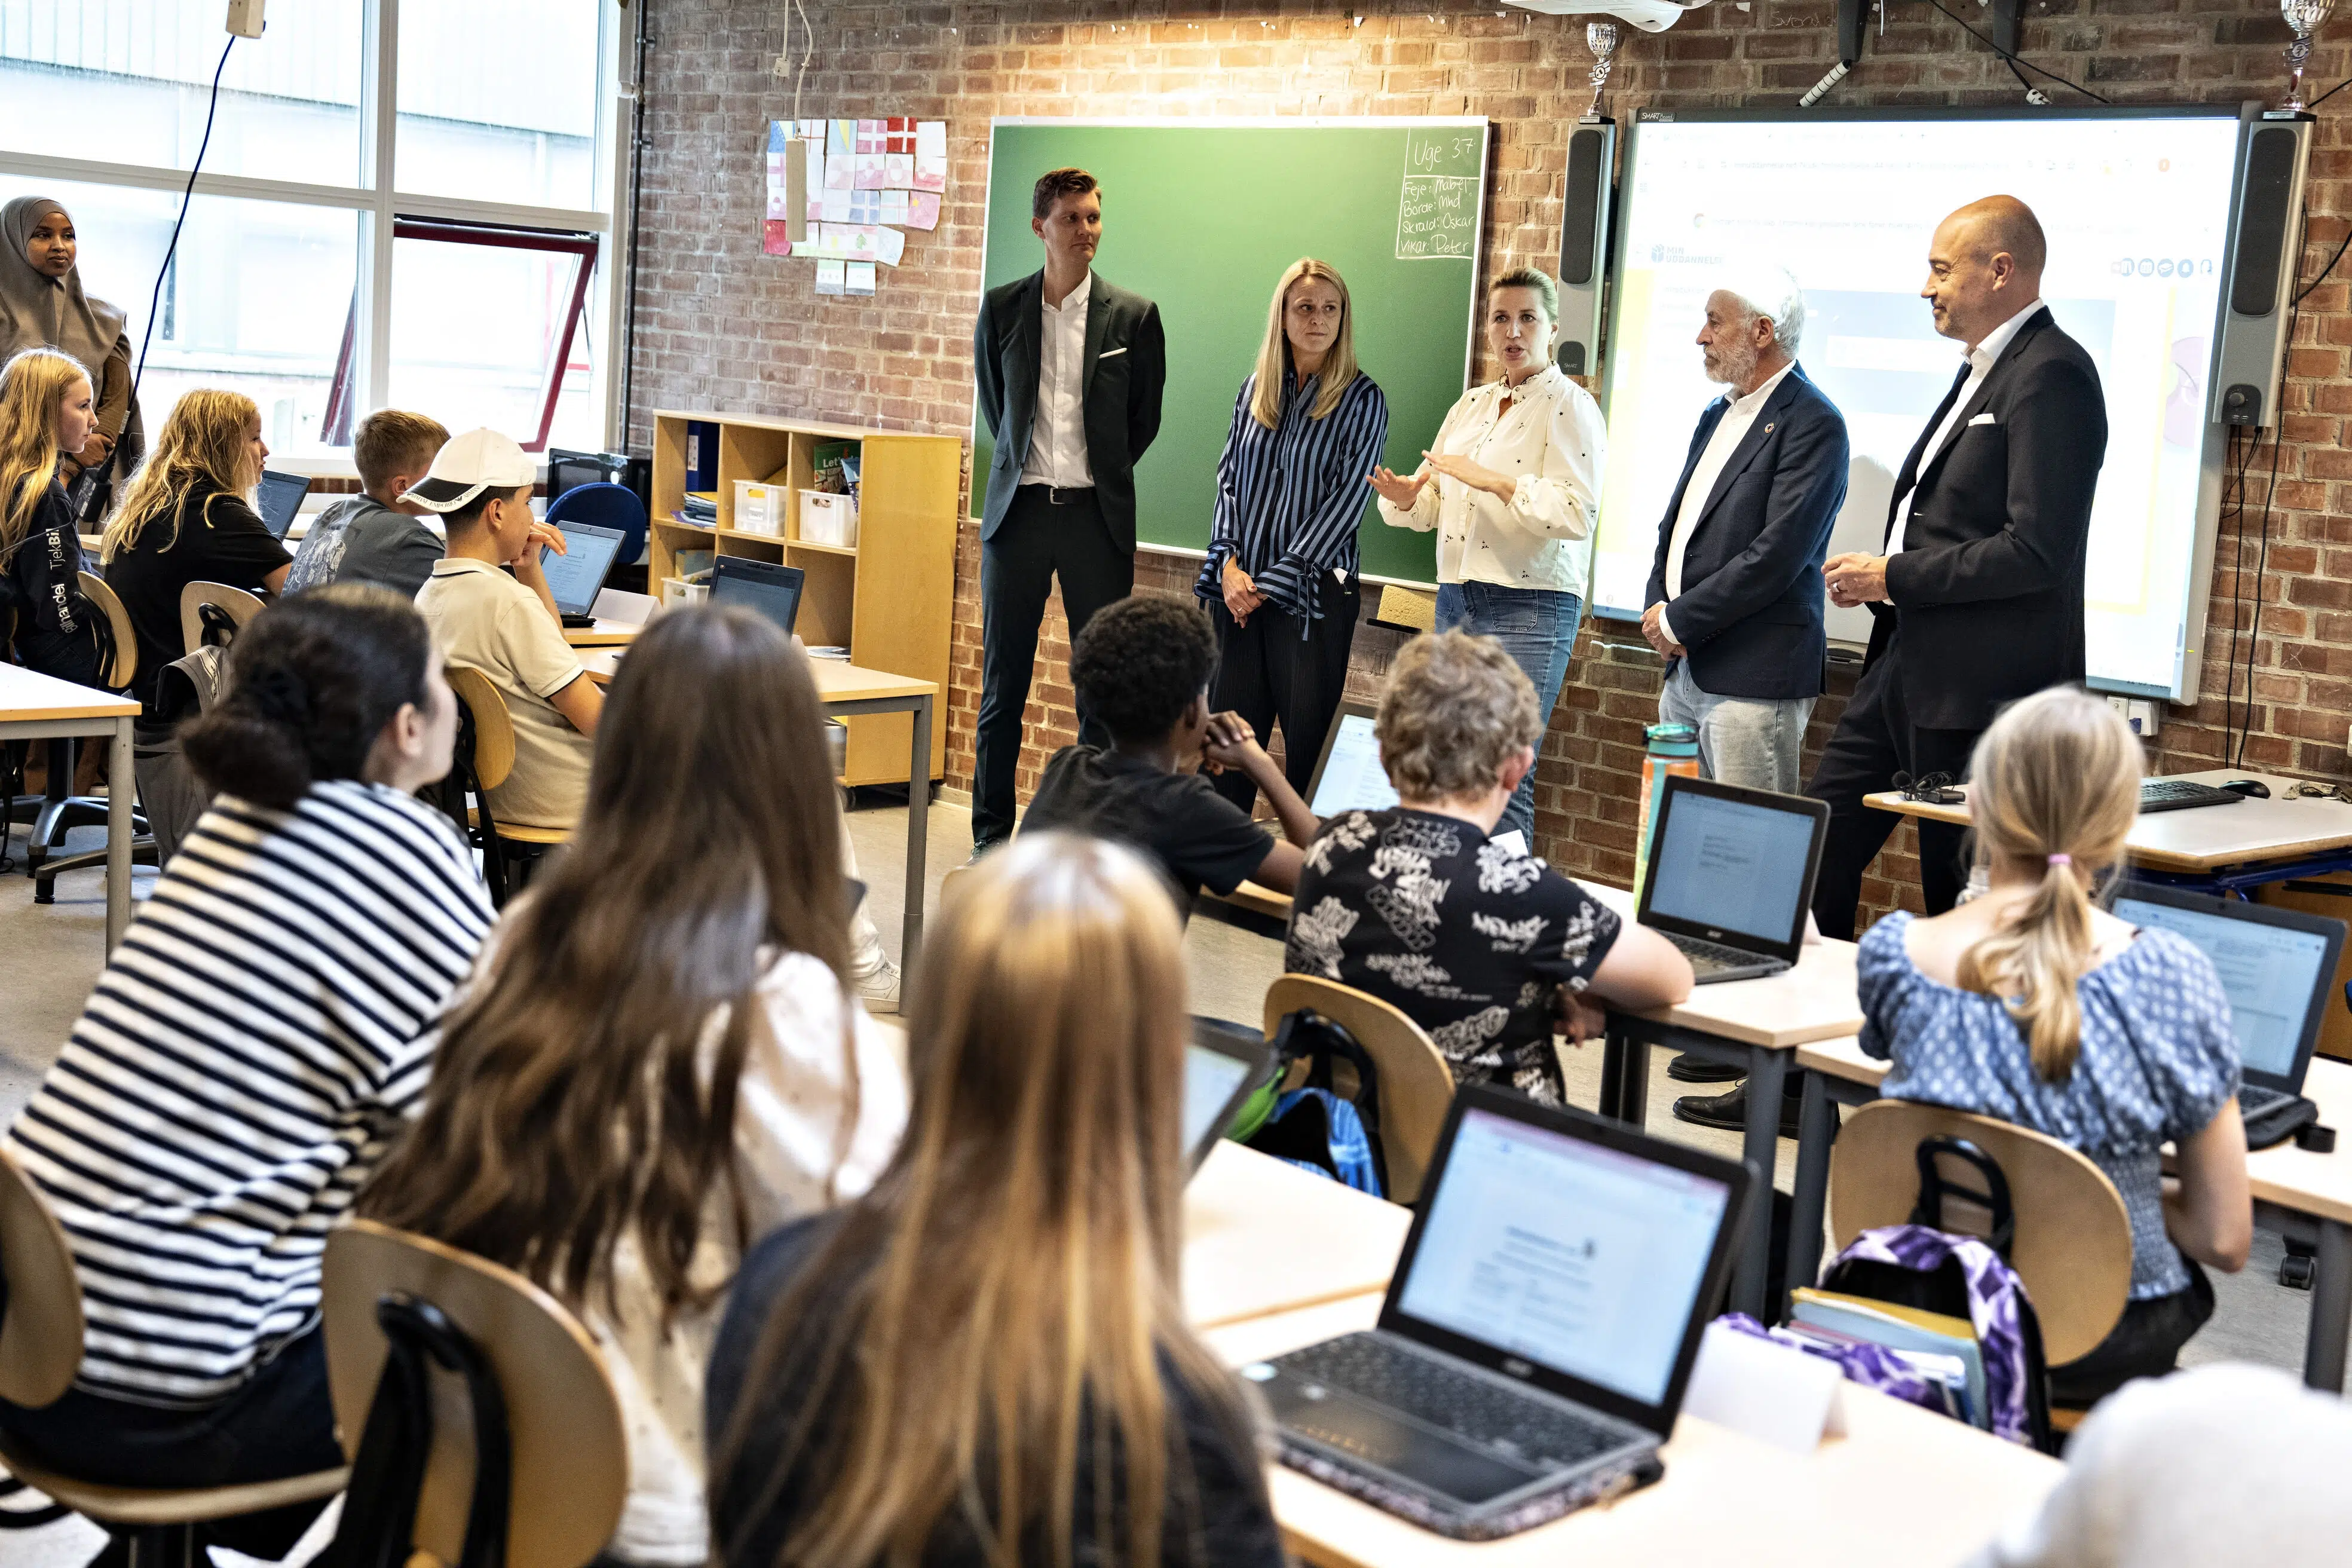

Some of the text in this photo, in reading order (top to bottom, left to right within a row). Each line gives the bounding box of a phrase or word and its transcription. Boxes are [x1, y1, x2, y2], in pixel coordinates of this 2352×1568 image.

[1414, 137, 1474, 172] Uge 37
[1402, 213, 1475, 234] Skrald: Oskar
[1431, 234, 1469, 254] Peter
[1667, 247, 1685, 255] MIN
[411, 492, 428, 504] ARMANI
[46, 528, 66, 571] TjekBil
